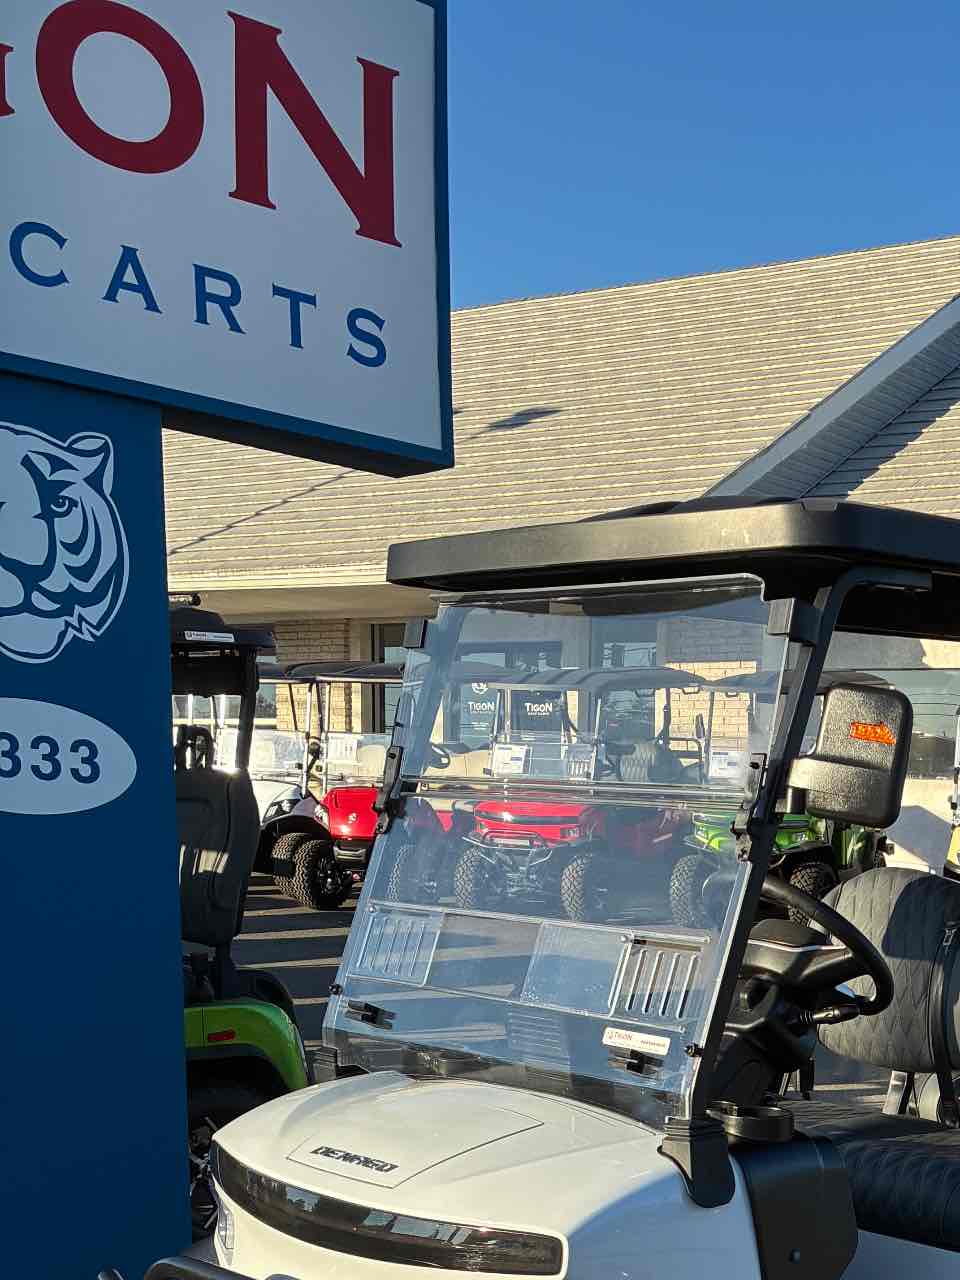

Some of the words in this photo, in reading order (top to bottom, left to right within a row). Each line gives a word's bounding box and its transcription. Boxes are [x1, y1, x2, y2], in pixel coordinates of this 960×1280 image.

[0, 0, 402, 248] ON
[9, 221, 388, 368] CARTS
[524, 702, 553, 712] TIGON
